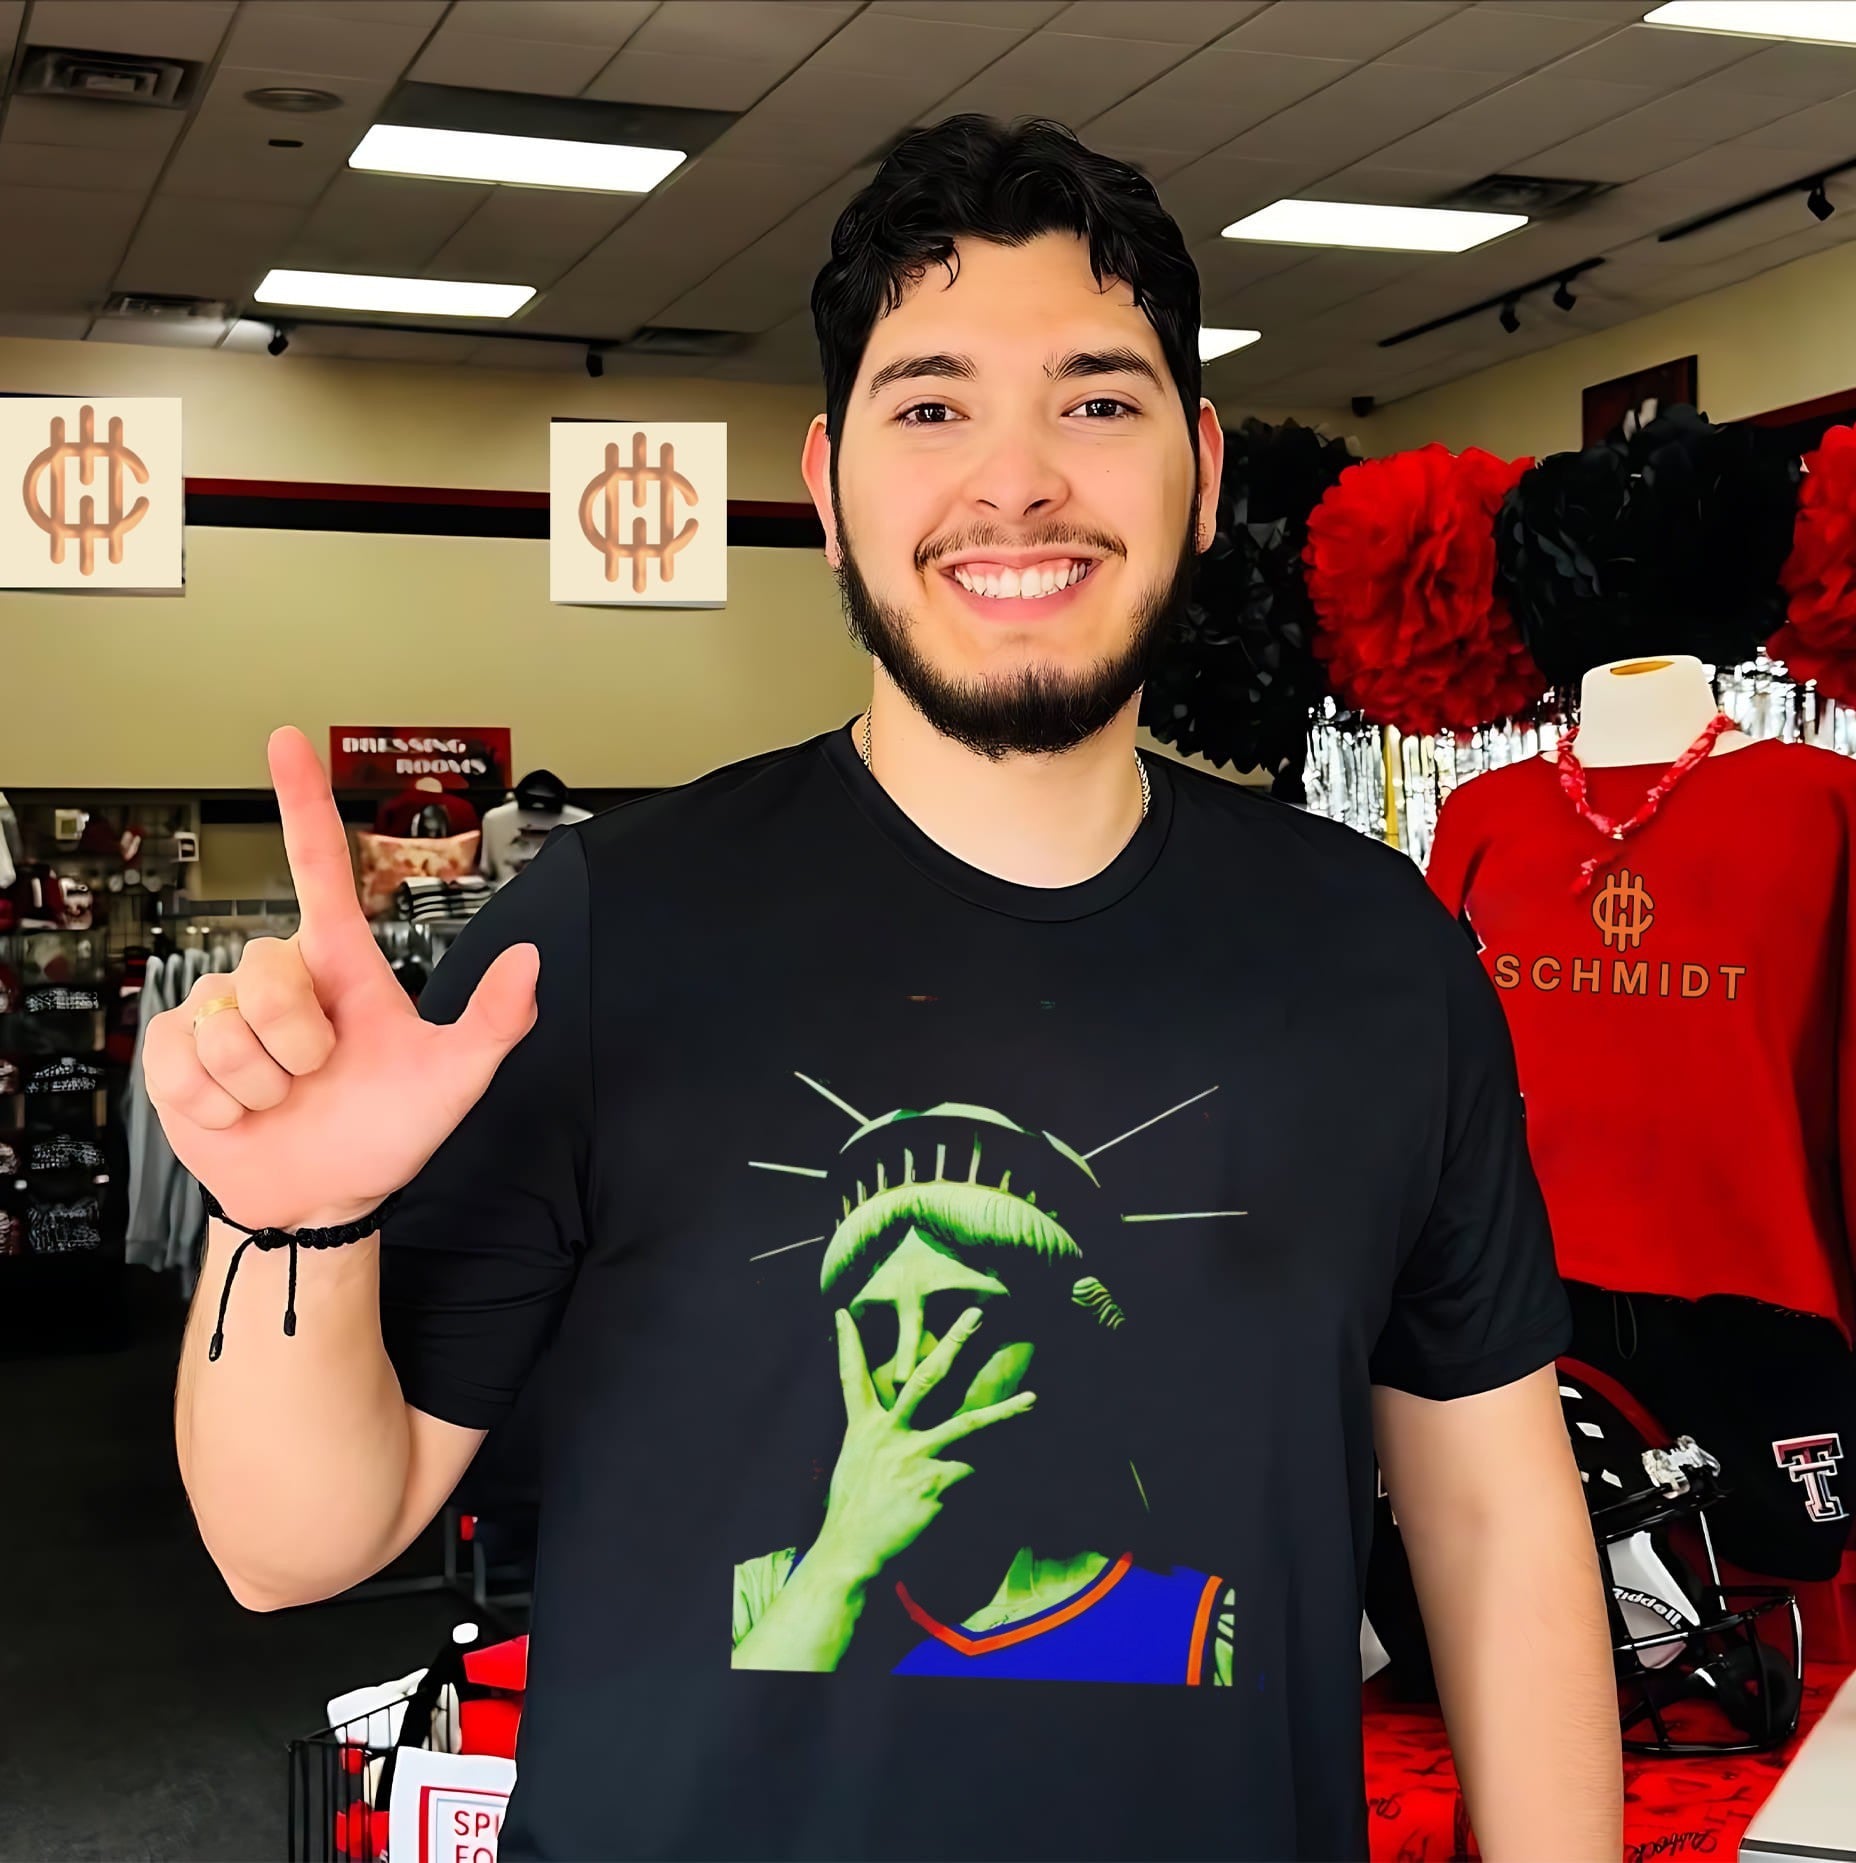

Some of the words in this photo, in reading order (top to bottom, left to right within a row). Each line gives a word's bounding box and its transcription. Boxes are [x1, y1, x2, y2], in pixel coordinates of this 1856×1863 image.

[341, 737, 467, 754] DRESSING
[395, 758, 487, 776] ROOMS
[1494, 954, 1747, 1000] SCHMIDT
